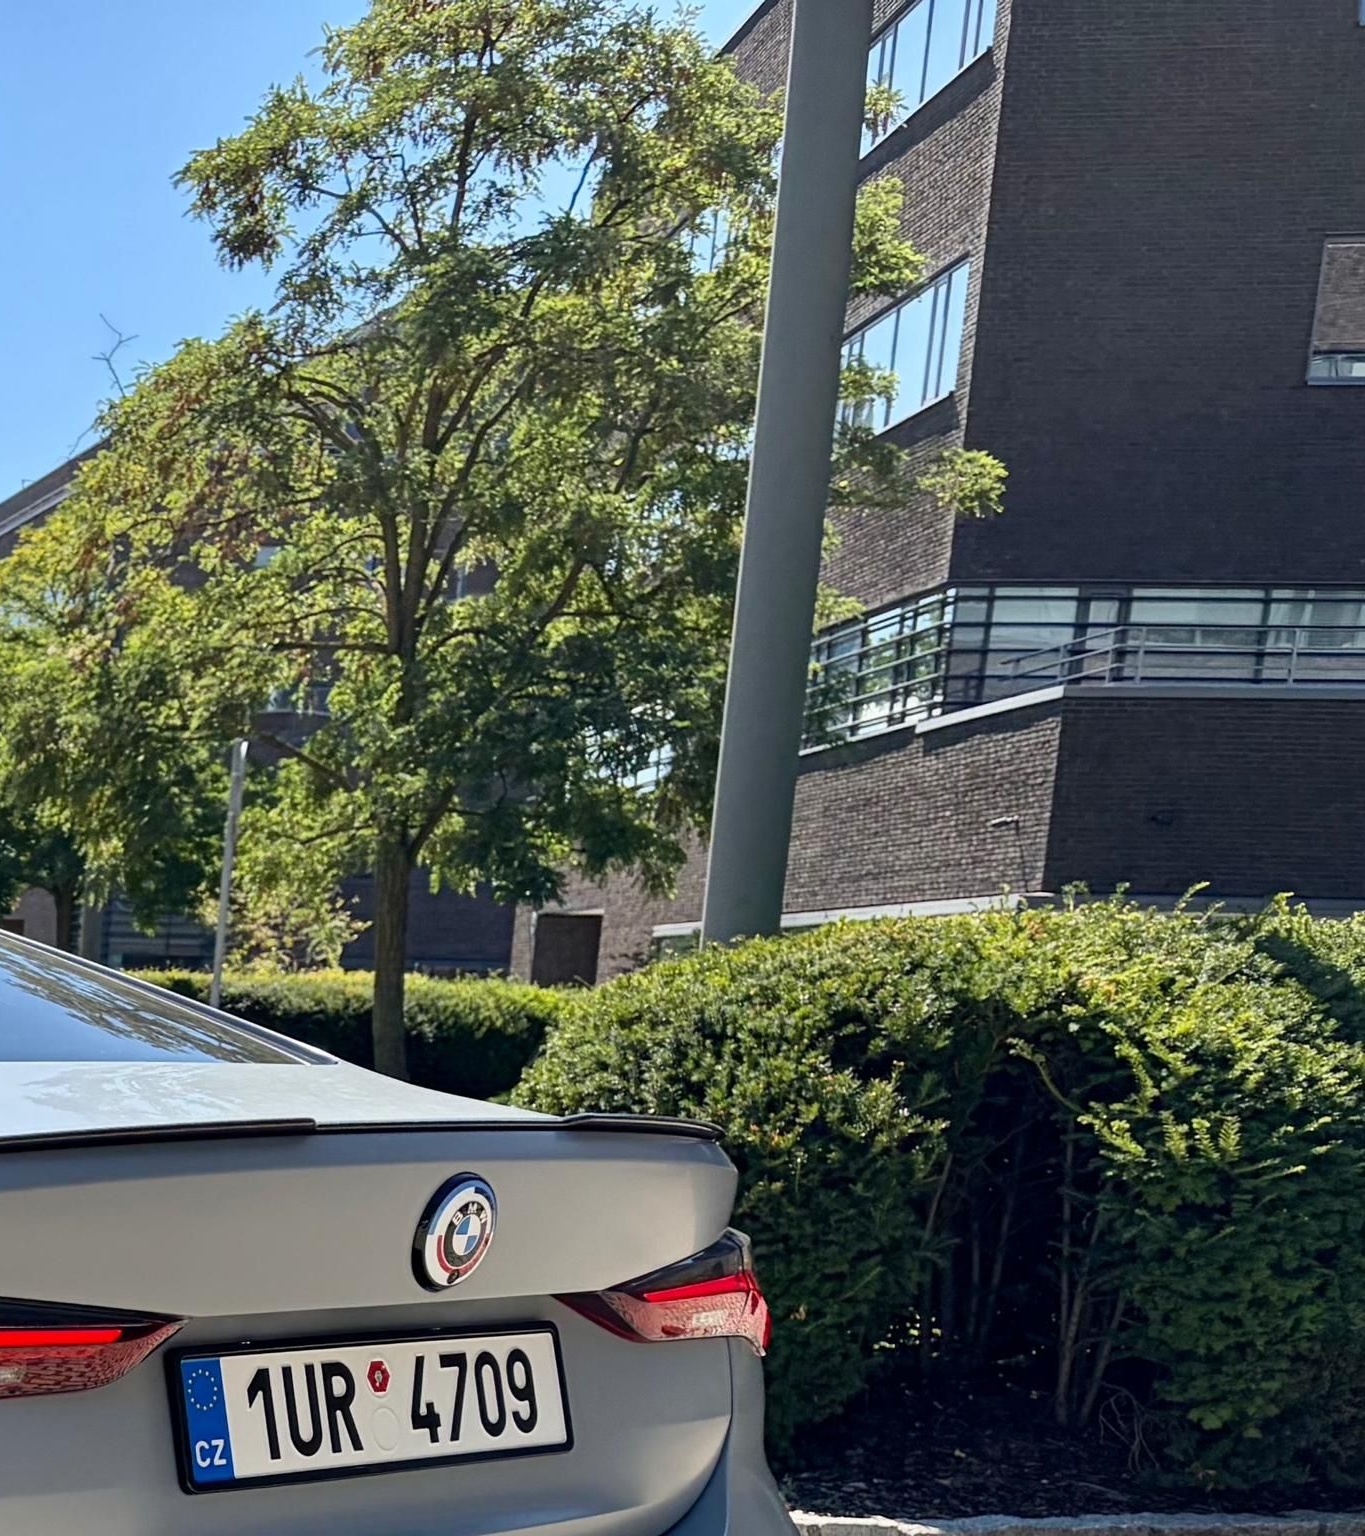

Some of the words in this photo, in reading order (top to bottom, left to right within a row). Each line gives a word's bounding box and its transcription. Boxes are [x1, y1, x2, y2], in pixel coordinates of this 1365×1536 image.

[452, 1202, 488, 1226] BMW
[247, 1360, 365, 1461] 1UR
[410, 1347, 538, 1444] 4709
[195, 1438, 228, 1468] CZ
